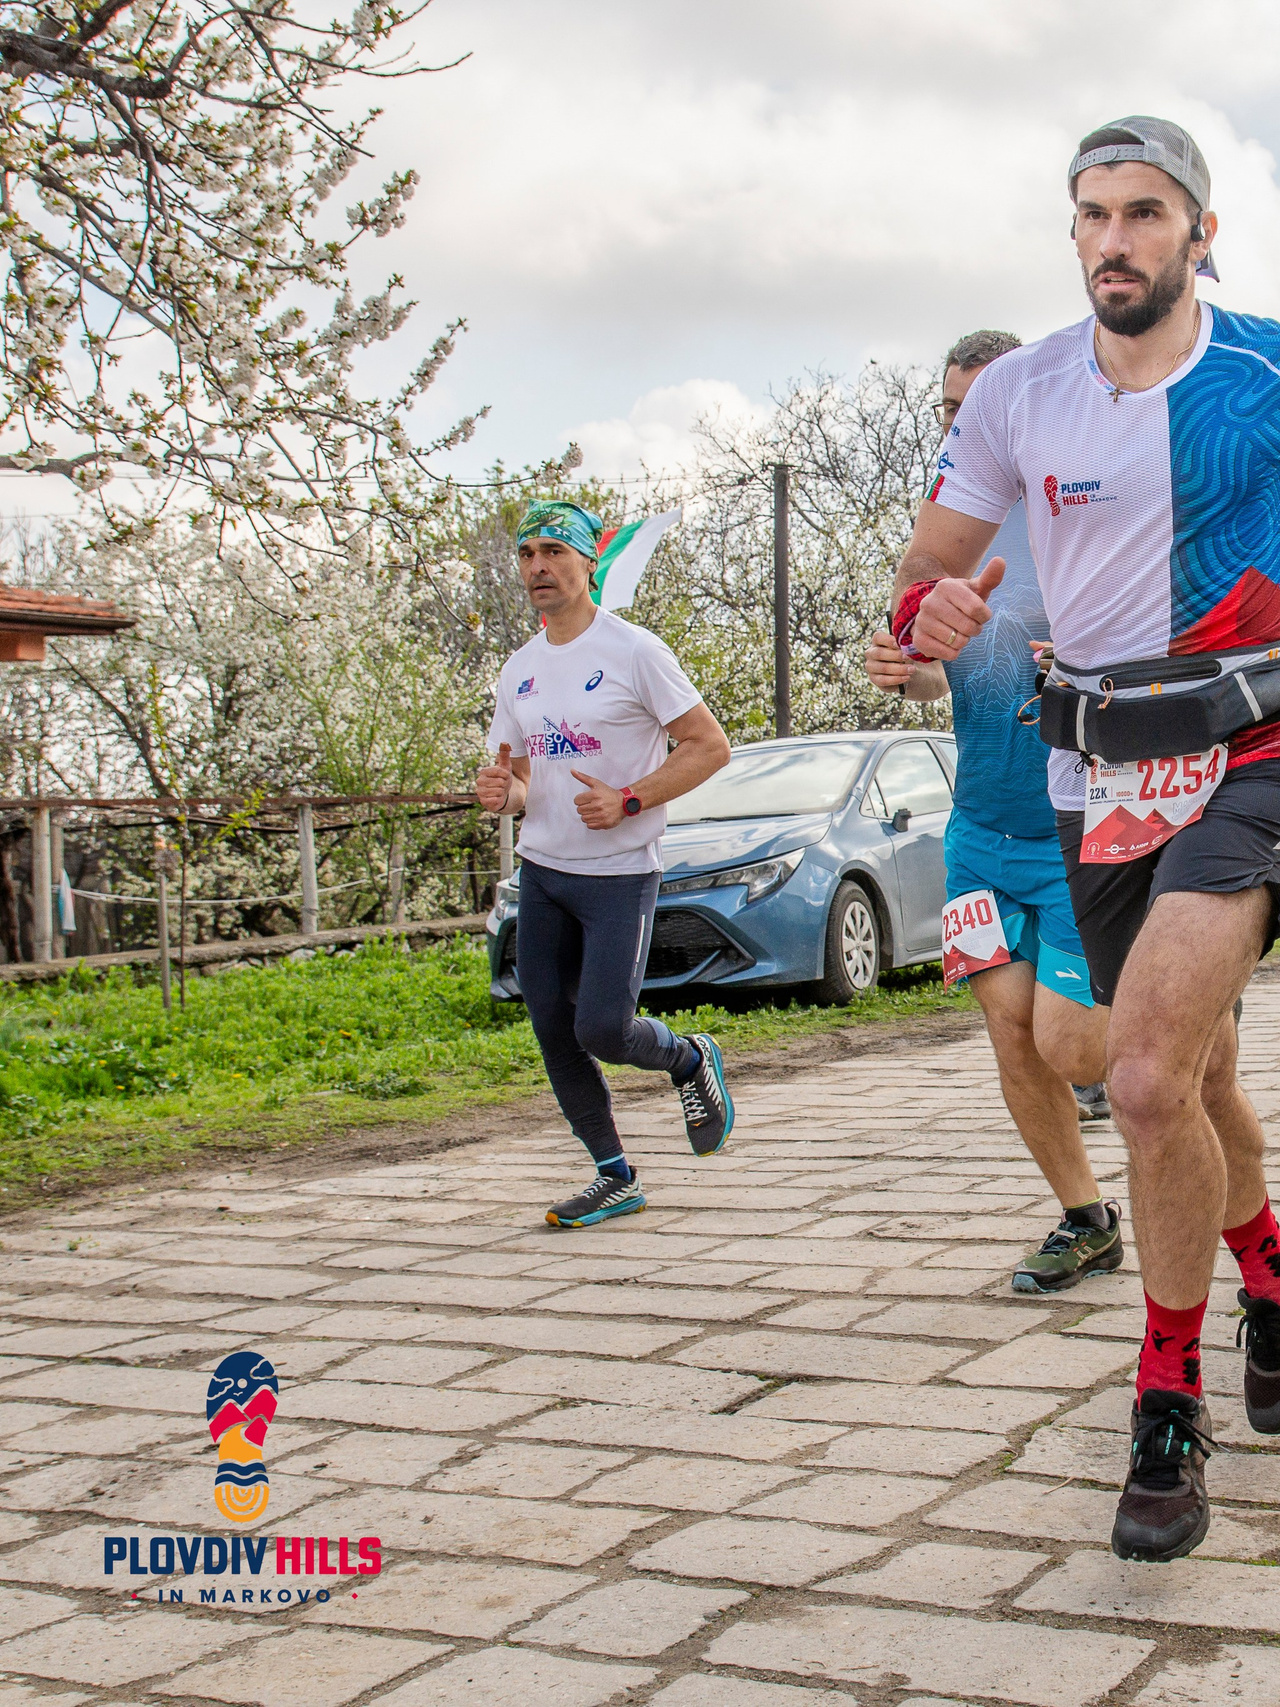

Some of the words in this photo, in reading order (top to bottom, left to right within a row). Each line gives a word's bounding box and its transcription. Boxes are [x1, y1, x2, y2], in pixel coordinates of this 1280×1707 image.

[1061, 480, 1100, 494] PLOVDIV
[1062, 494, 1088, 506] HILLS
[547, 753, 581, 761] MARATHON
[585, 749, 603, 758] 2024
[1137, 748, 1220, 801] 2254
[1089, 786, 1108, 800] 22K
[943, 898, 993, 942] 2340
